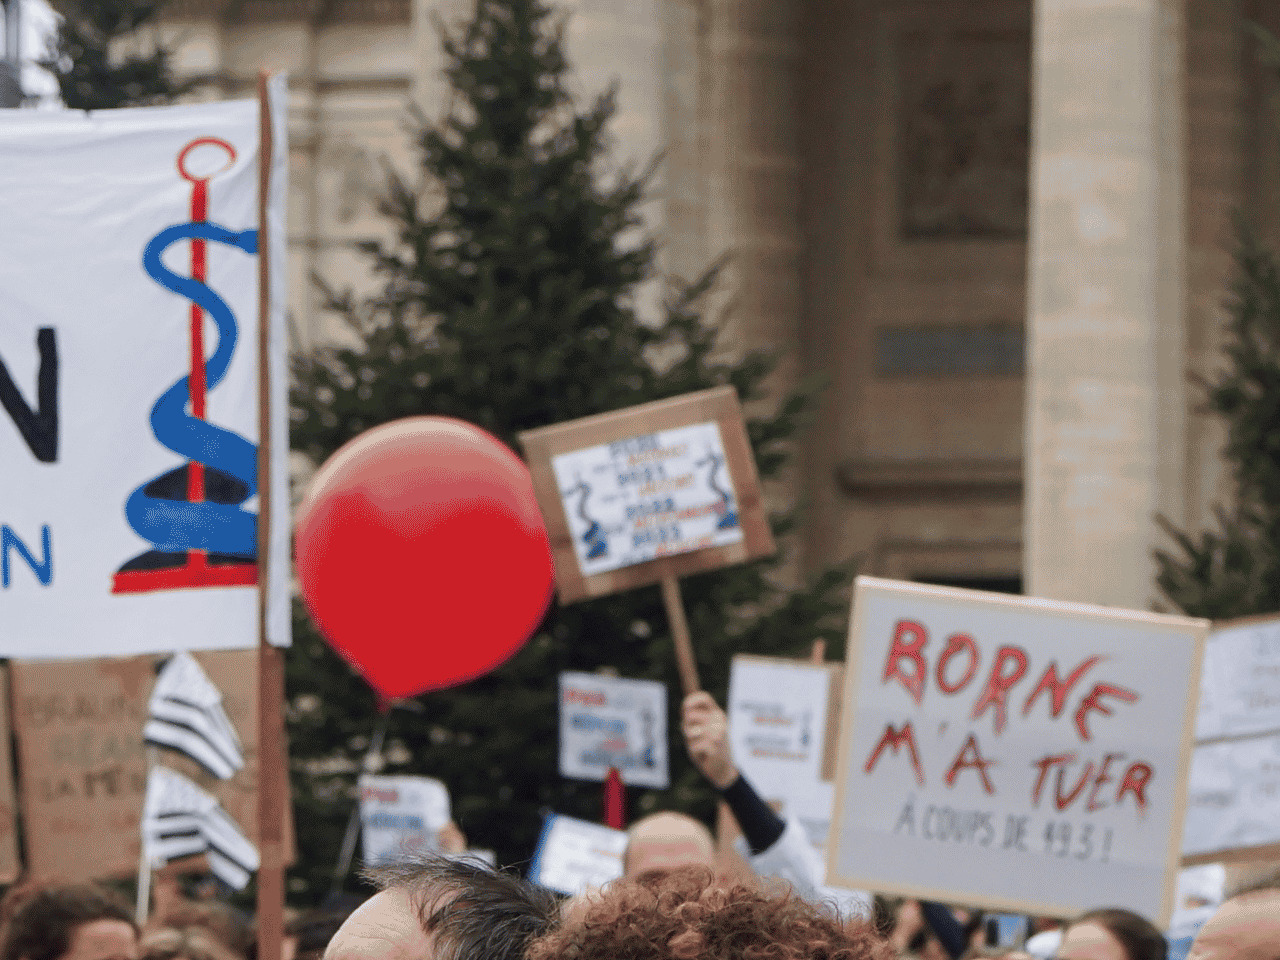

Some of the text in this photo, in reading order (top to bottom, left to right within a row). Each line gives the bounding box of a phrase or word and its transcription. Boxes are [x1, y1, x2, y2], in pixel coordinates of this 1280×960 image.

[881, 617, 1142, 742] BORNE
[862, 719, 1000, 796] M'A
[1029, 751, 1154, 819] TUER
[921, 804, 996, 847] COUPS
